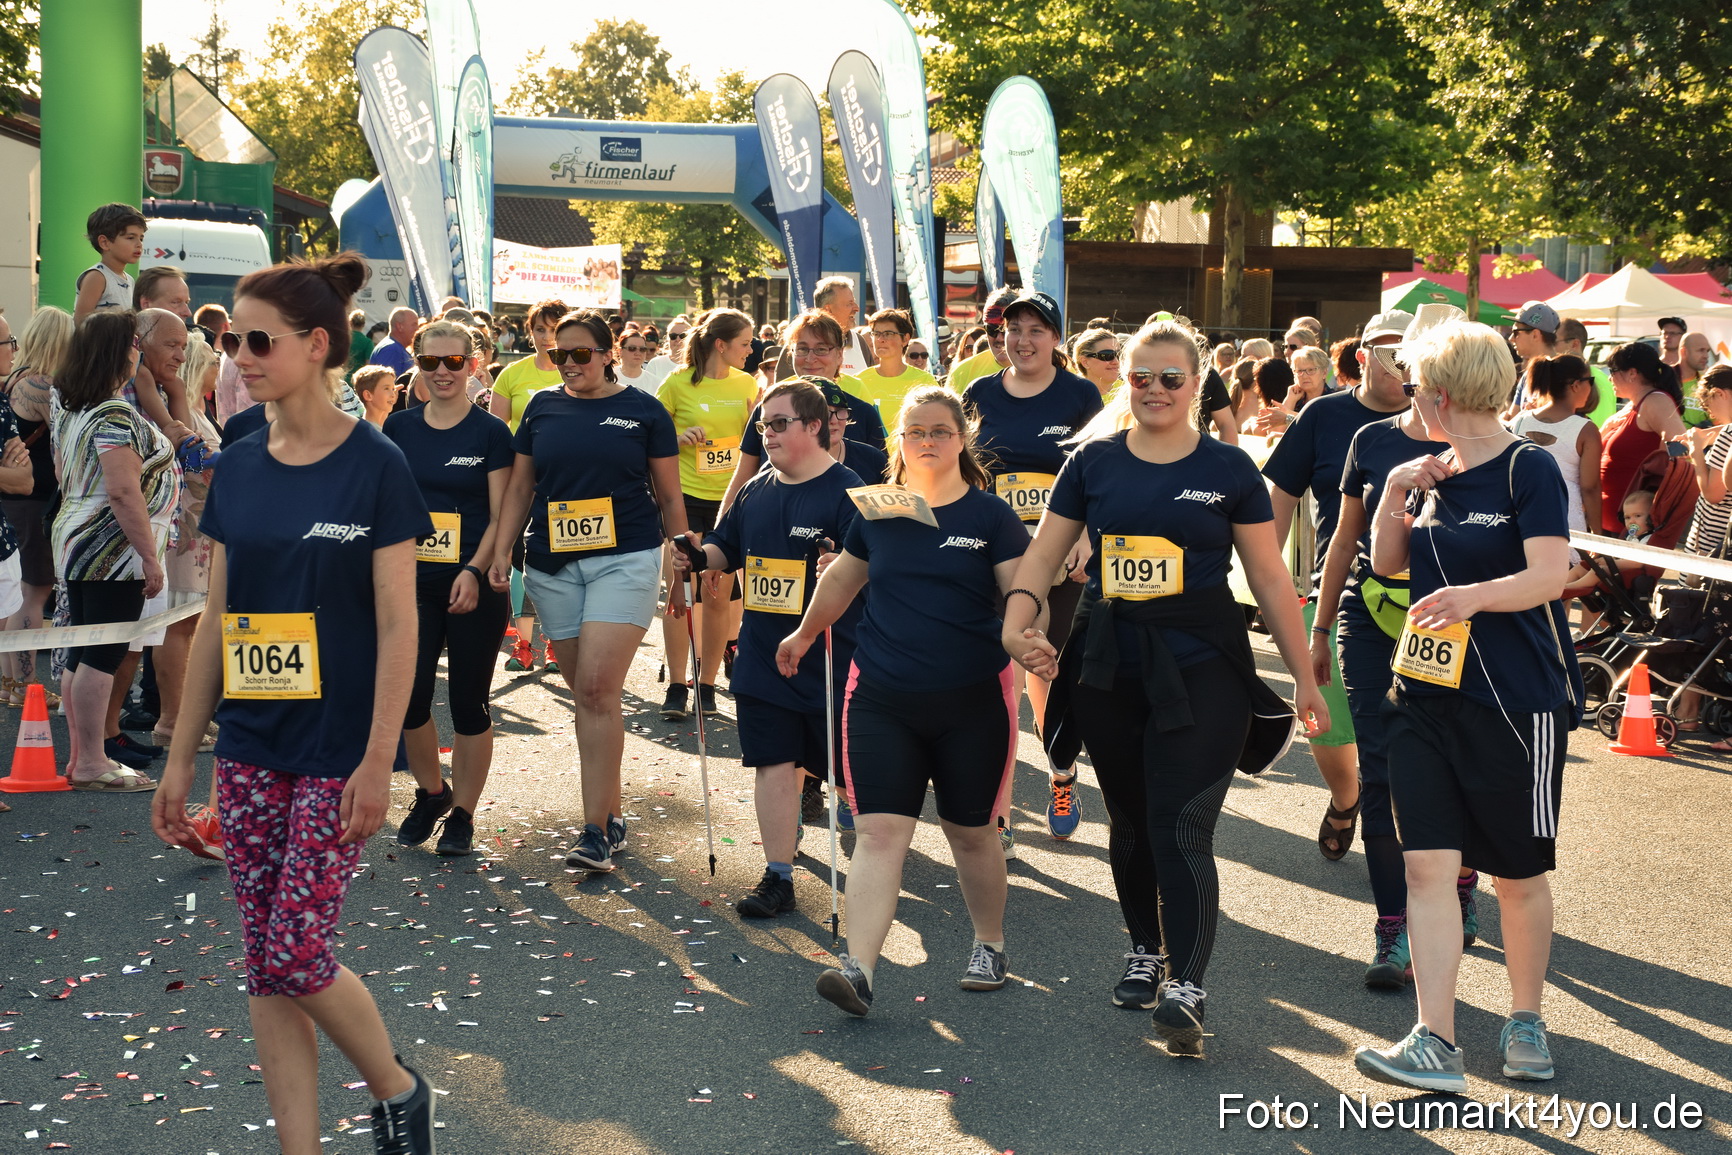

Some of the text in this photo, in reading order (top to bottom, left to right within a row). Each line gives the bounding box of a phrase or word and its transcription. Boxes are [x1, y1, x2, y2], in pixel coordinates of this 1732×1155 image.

[609, 143, 640, 154] Fischer
[585, 161, 677, 180] firmenlauf
[599, 417, 629, 427] JURA
[1038, 426, 1064, 437] JURA
[444, 456, 474, 466] JURA
[707, 450, 732, 464] 954
[1005, 489, 1051, 507] 1090
[1174, 489, 1212, 501] JURA
[1459, 512, 1495, 525] JURA
[302, 522, 351, 539] JURA
[556, 516, 604, 538] 1067
[939, 536, 975, 548] JURA
[1111, 558, 1167, 582] 1091
[751, 576, 795, 598] 1097
[234, 644, 304, 675] 1064
[1414, 667, 1434, 675] Neumarkt
[1415, 660, 1451, 674] Dominique
[245, 676, 291, 685] Schorr Ronja
